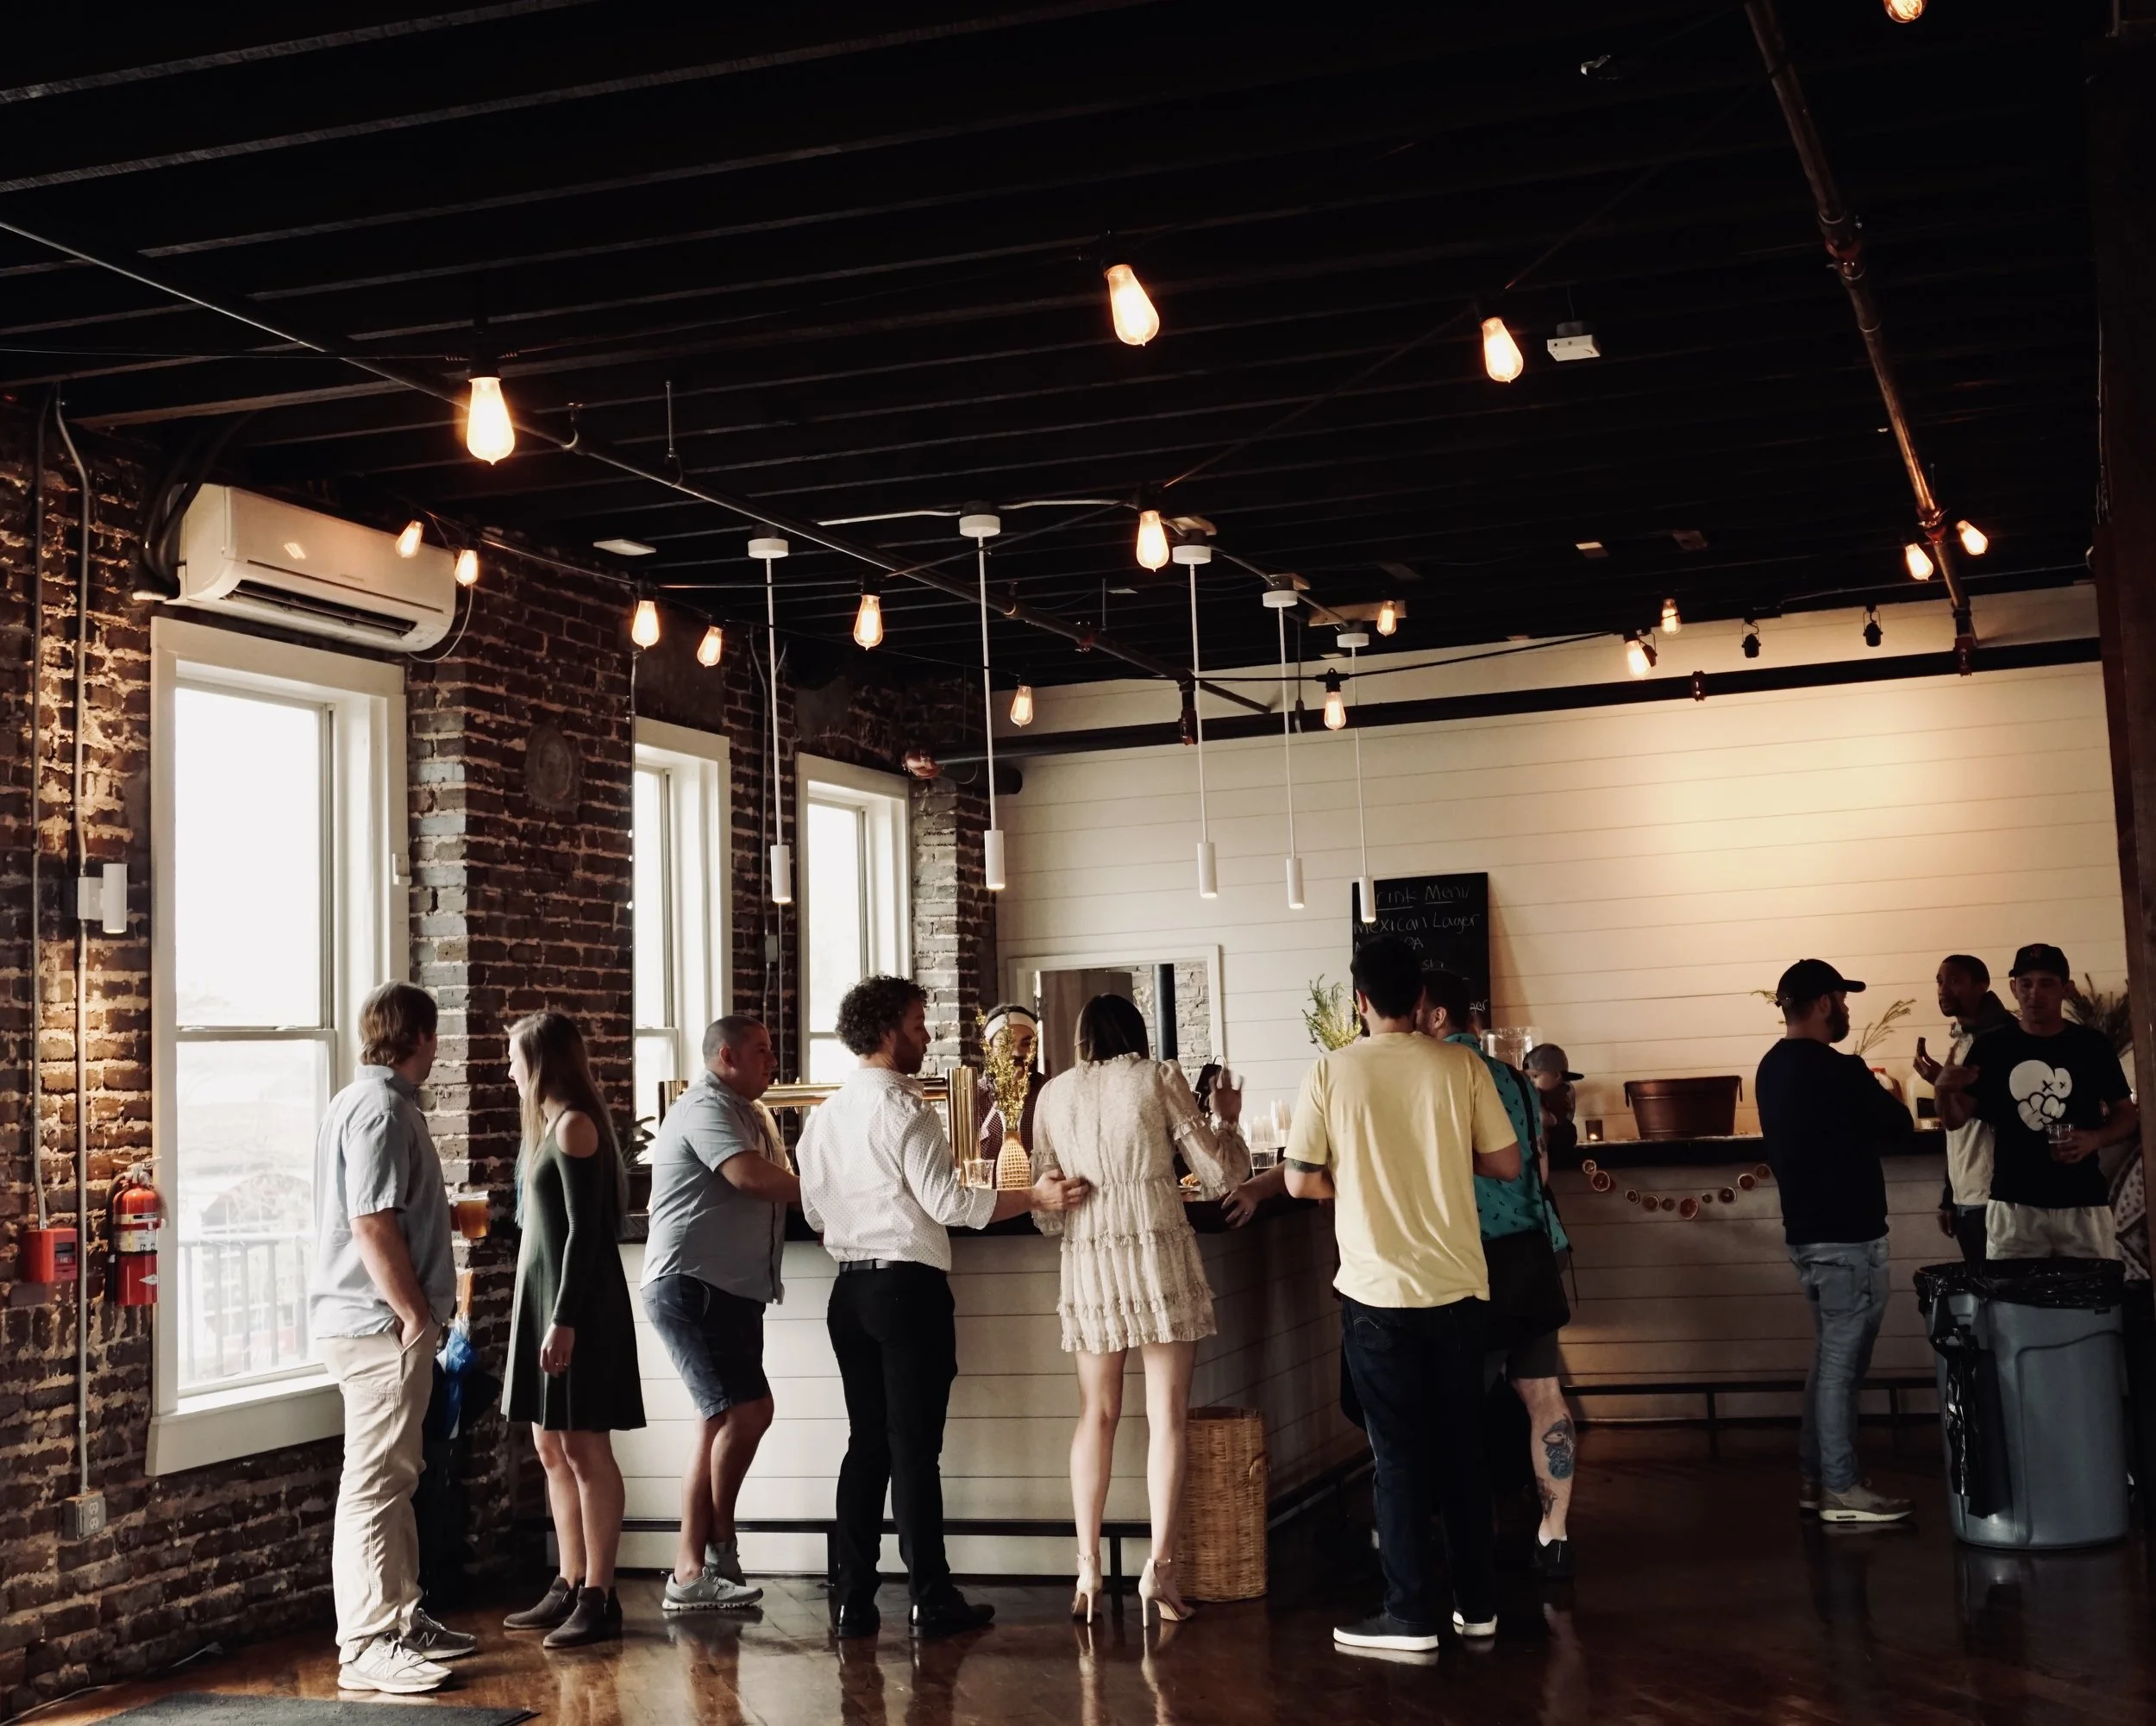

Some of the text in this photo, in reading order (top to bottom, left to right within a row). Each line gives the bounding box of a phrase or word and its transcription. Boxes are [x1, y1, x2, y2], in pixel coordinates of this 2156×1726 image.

[1376, 884, 1470, 906] rink Menu
[1433, 912, 1480, 934] Lager
